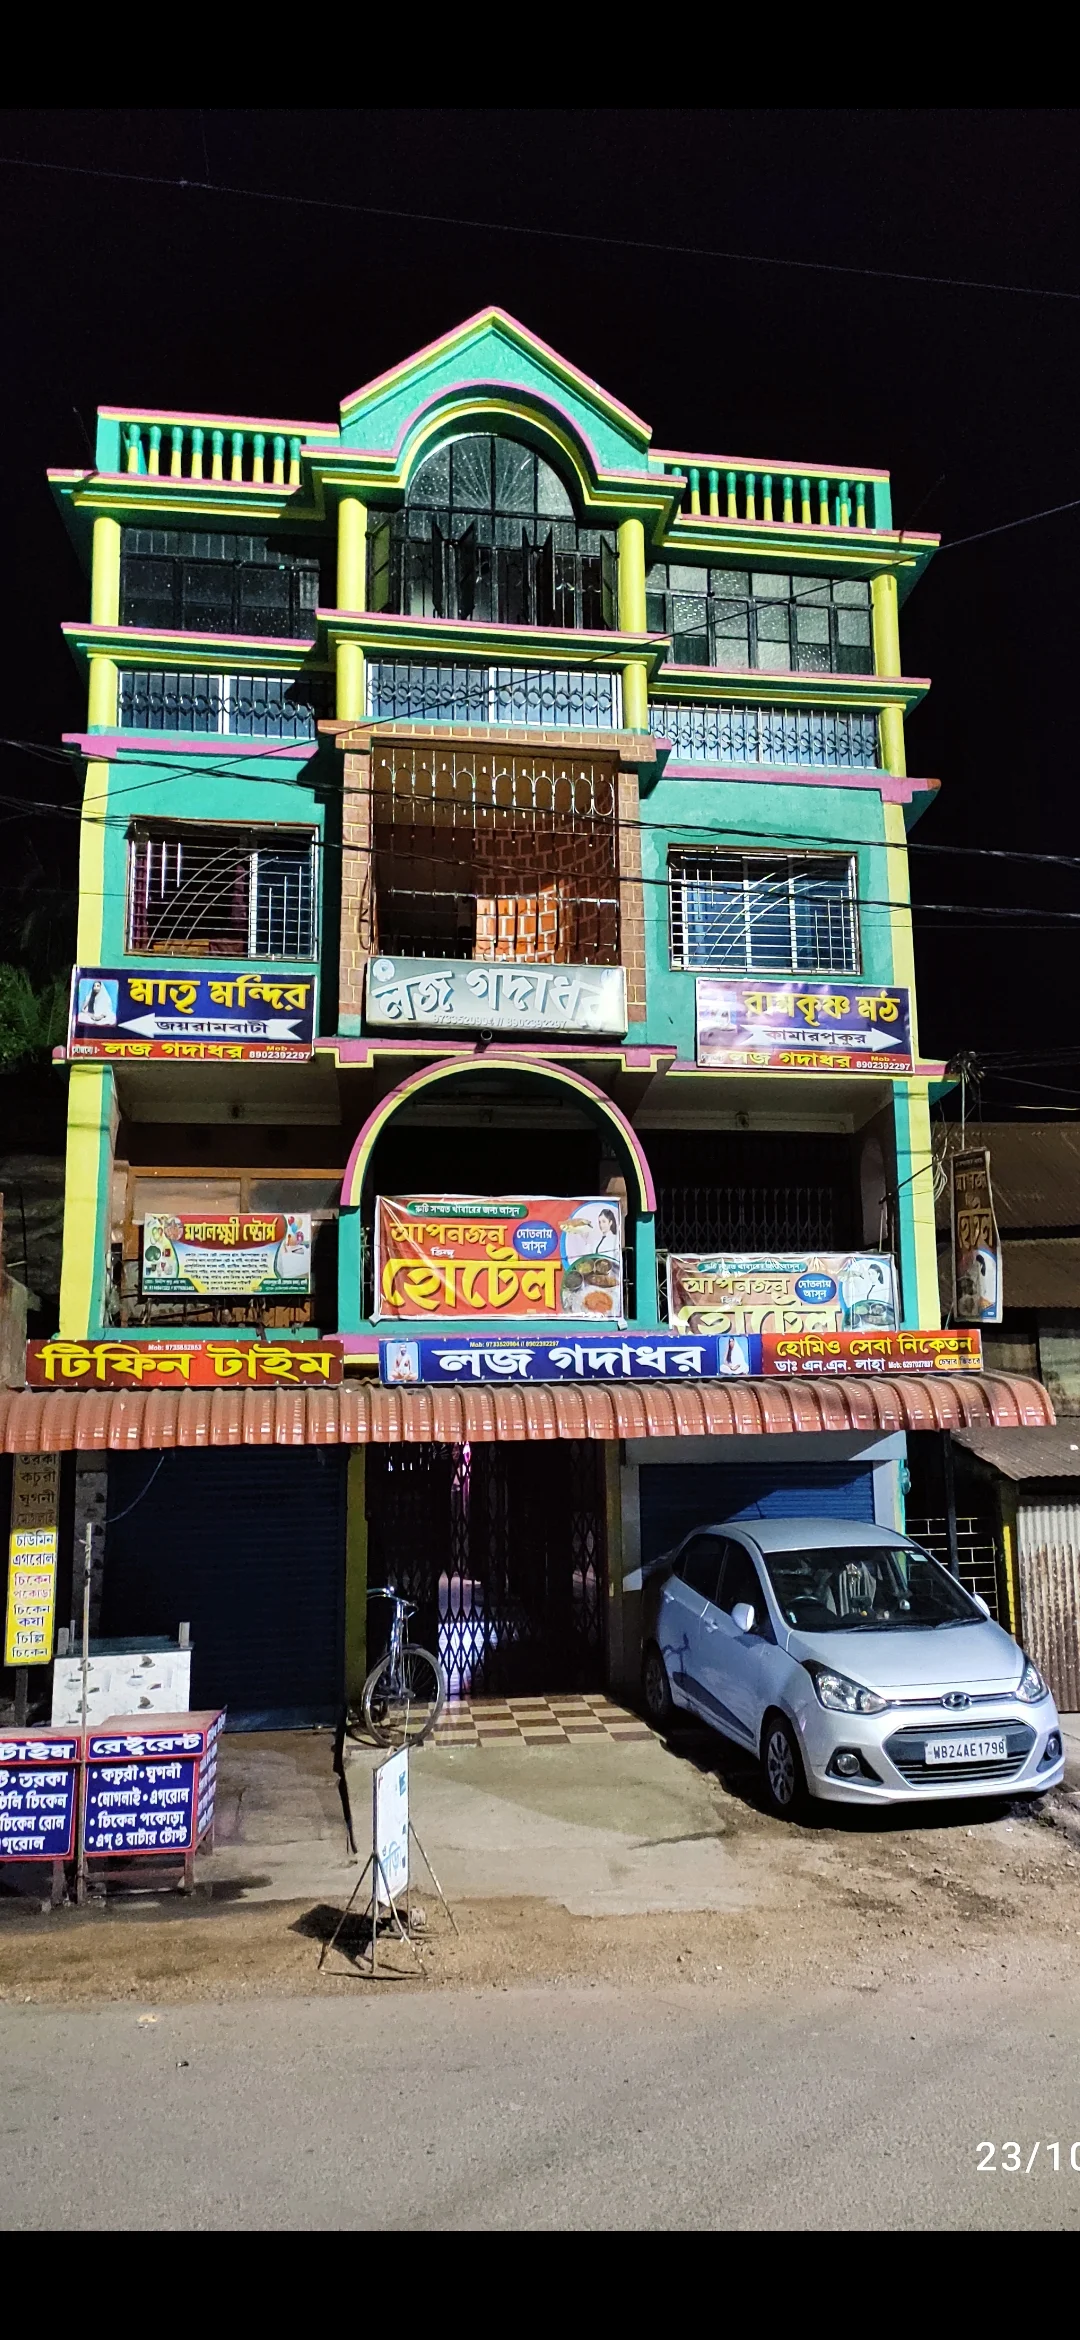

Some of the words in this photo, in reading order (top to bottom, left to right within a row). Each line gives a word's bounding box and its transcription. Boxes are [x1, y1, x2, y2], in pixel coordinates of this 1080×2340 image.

[128, 978, 200, 1014] মাতৃ
[208, 975, 310, 1011] মন্দির
[371, 970, 455, 1020] লজ
[466, 968, 606, 1027] গদাধর
[742, 991, 850, 1026] রামকৃষ্ণ
[856, 990, 900, 1023] মঠ
[155, 1020, 269, 1034] জয়রামবাটী
[763, 1030, 867, 1046] কামারপুকুর
[101, 1042, 153, 1058] লজ
[161, 1043, 244, 1059] গদাধর
[728, 1051, 771, 1065] লজ
[779, 1052, 852, 1069] গদাধর
[184, 1217, 240, 1245] মহালক্ষ্মী
[390, 1223, 507, 1246] আপনজন
[517, 1228, 553, 1239] দোতলায়
[521, 1240, 548, 1254] আসুন
[382, 1243, 562, 1311] হোটেল
[682, 1277, 790, 1295] আপনজন
[798, 1280, 832, 1290] দোতলায়
[803, 1289, 828, 1300] আসুন
[777, 1335, 842, 1358] হোমিও
[849, 1337, 893, 1357] সেবা
[896, 1334, 973, 1356] নিকেতন
[35, 1342, 197, 1381] টিফিন
[206, 1343, 336, 1382] টাইম
[431, 1349, 536, 1378] লজ
[548, 1343, 707, 1377] গদাধর
[774, 1359, 798, 1373] ডাঃ
[854, 1358, 886, 1373] লাহা
[20, 1467, 56, 1487] কচুরী
[16, 1530, 54, 1547] চাউমিন
[14, 1571, 51, 1586] চিকেন
[14, 1603, 50, 1615] চিকেন
[12, 1647, 48, 1659] চিকেন
[933, 1741, 1005, 1759] WB24AE1798
[19, 1771, 68, 1788] তরকা
[25, 1789, 68, 1809] চিকেন
[39, 1815, 66, 1832] রোল
[98, 1810, 137, 1828] চিকেন
[115, 1832, 123, 1847] ও
[126, 1828, 157, 1846] বাটার
